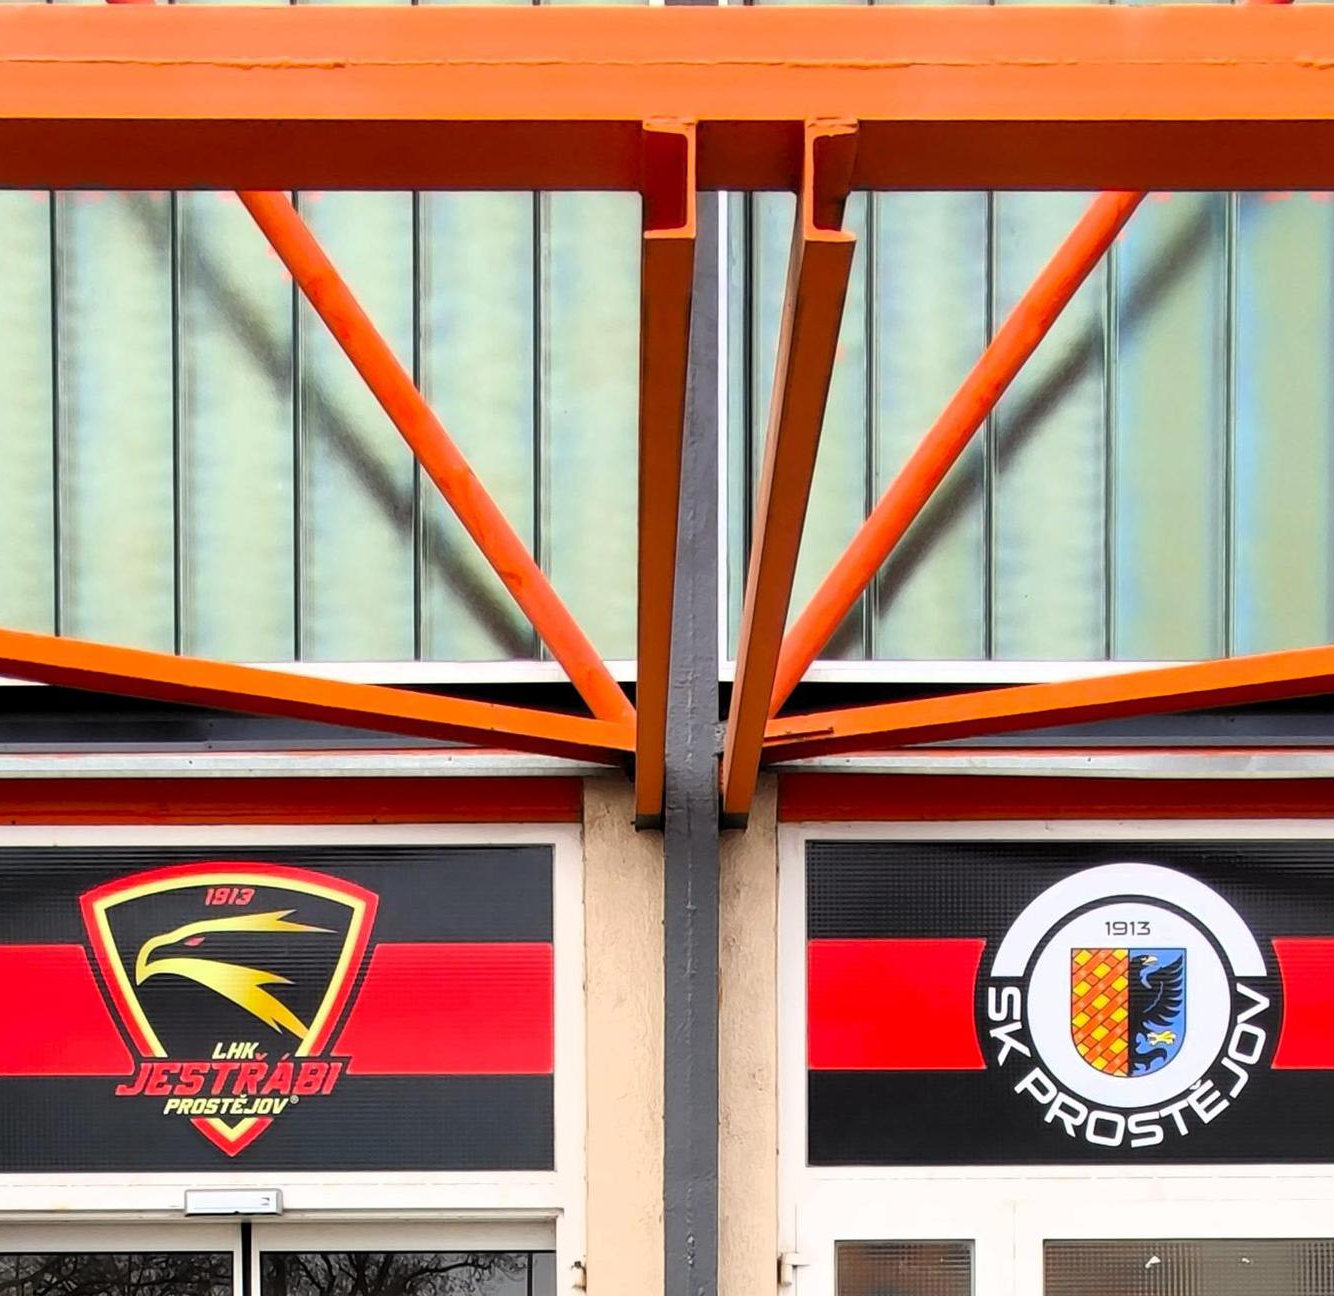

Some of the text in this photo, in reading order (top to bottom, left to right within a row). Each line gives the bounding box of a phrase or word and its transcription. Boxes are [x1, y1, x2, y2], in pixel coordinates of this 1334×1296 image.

[205, 888, 255, 905] 1913
[1105, 921, 1151, 936] 1913
[212, 1042, 259, 1059] LHK
[988, 982, 1270, 1148] SK PROSTĚJOV
[115, 1053, 344, 1096] JESTŘÁBI
